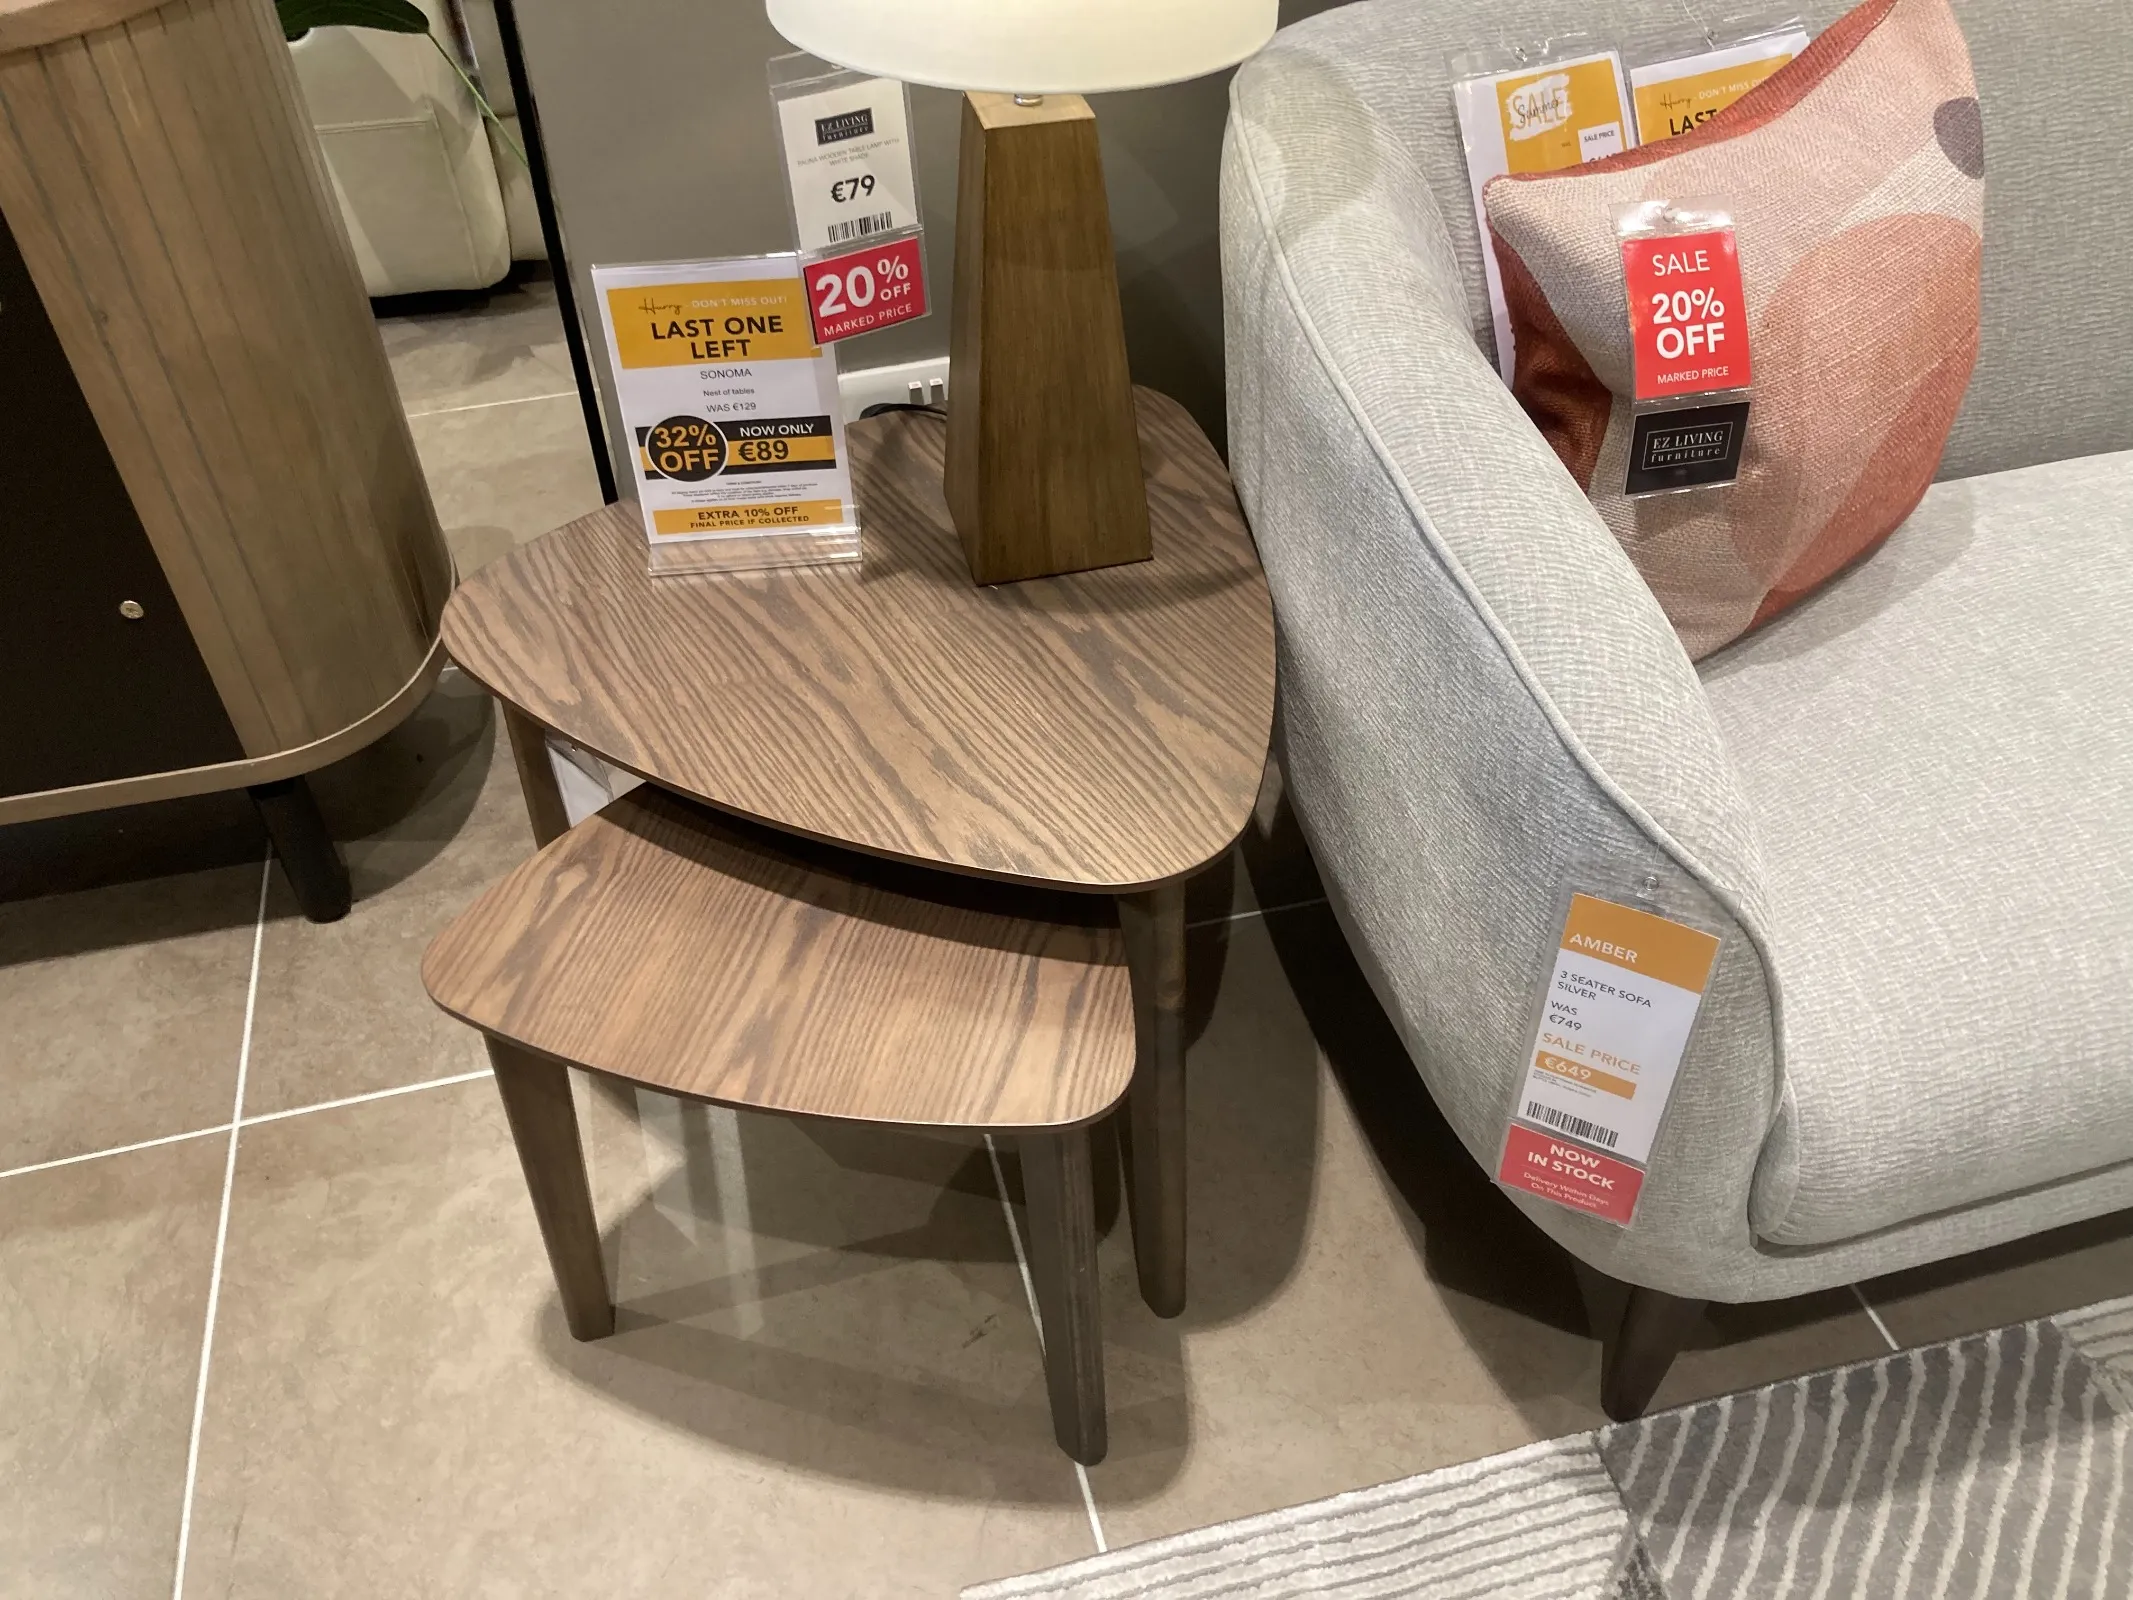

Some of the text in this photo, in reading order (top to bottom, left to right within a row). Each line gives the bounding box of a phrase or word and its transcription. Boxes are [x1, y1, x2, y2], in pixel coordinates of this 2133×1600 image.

[1699, 87, 1726, 99] DON'T
[1729, 82, 1749, 93] MISS
[1669, 108, 1717, 136] LAST
[1584, 130, 1615, 142] SALE PRICE
[831, 174, 876, 203] €79
[1652, 250, 1710, 277] SALE
[816, 255, 911, 318] 20% OFF
[692, 297, 727, 308] DON'T
[730, 297, 757, 307] MISS
[1652, 287, 1725, 325] 20%
[651, 316, 784, 340] LAST ONE
[824, 303, 912, 336] MARKED PRICE
[691, 339, 751, 359] LEFT
[1657, 322, 1725, 359] OFF
[700, 368, 753, 380] SONOMA
[1657, 366, 1729, 385] MARKED PRICE
[731, 387, 755, 396] tables
[706, 402, 757, 413] WAS €129
[654, 423, 717, 448] 32%
[740, 423, 815, 437] NOW ONLY
[1653, 430, 1723, 449] EZ LIVING
[660, 449, 719, 473] OFF
[738, 439, 789, 462] €89
[1651, 447, 1721, 463] furniture
[698, 506, 799, 520] EXTRA 10% OFF
[720, 519, 745, 527] PRICE
[758, 515, 809, 524] COLLECTED
[1569, 933, 1638, 963] AMBER
[1557, 981, 1597, 1000] SILVER
[1560, 970, 1652, 1008] 3 SEATER SOFA
[1551, 1000, 1578, 1016] WAS
[1549, 1013, 1582, 1031] €749
[1542, 1032, 1642, 1076] SALE PRICE
[1544, 1056, 1592, 1080] €649
[1550, 1143, 1601, 1169] NOW
[1523, 1171, 1558, 1189] Delivery
[1527, 1151, 1616, 1191] IN STOCK
[1531, 1182, 1598, 1208] On This Product
